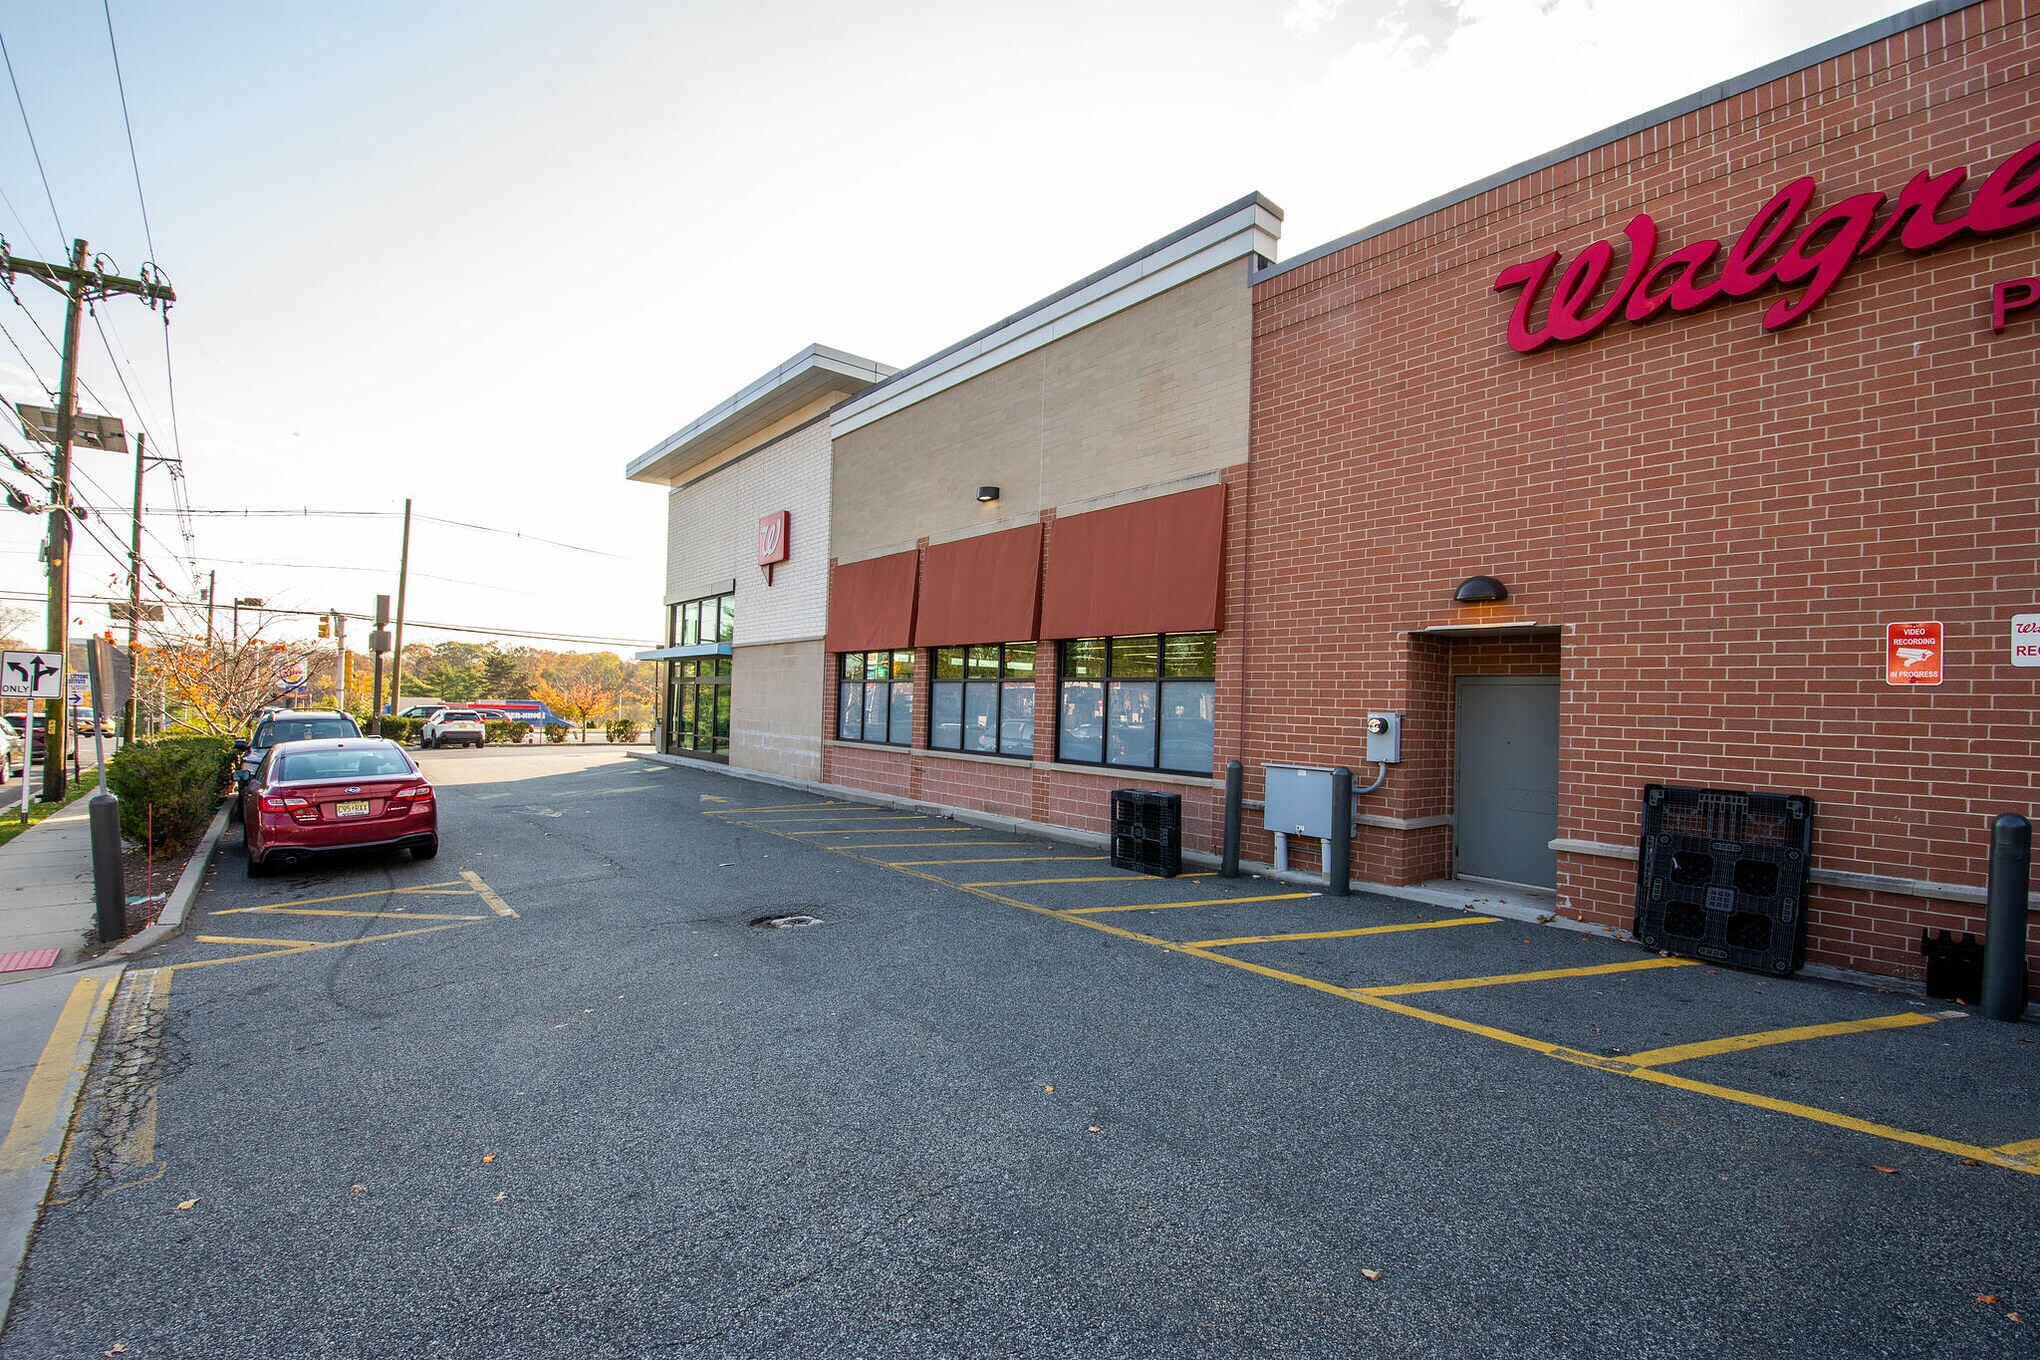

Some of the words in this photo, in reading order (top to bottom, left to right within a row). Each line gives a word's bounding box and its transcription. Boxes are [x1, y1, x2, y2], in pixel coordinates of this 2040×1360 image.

[1993, 277, 2040, 335] P
[761, 518, 781, 557] W
[1903, 628, 1926, 636] VIDEO
[1893, 637, 1936, 645] RECORDING
[2016, 645, 2040, 656] RE
[1899, 670, 1939, 678] PROGRESS
[2, 684, 30, 693] ONLY
